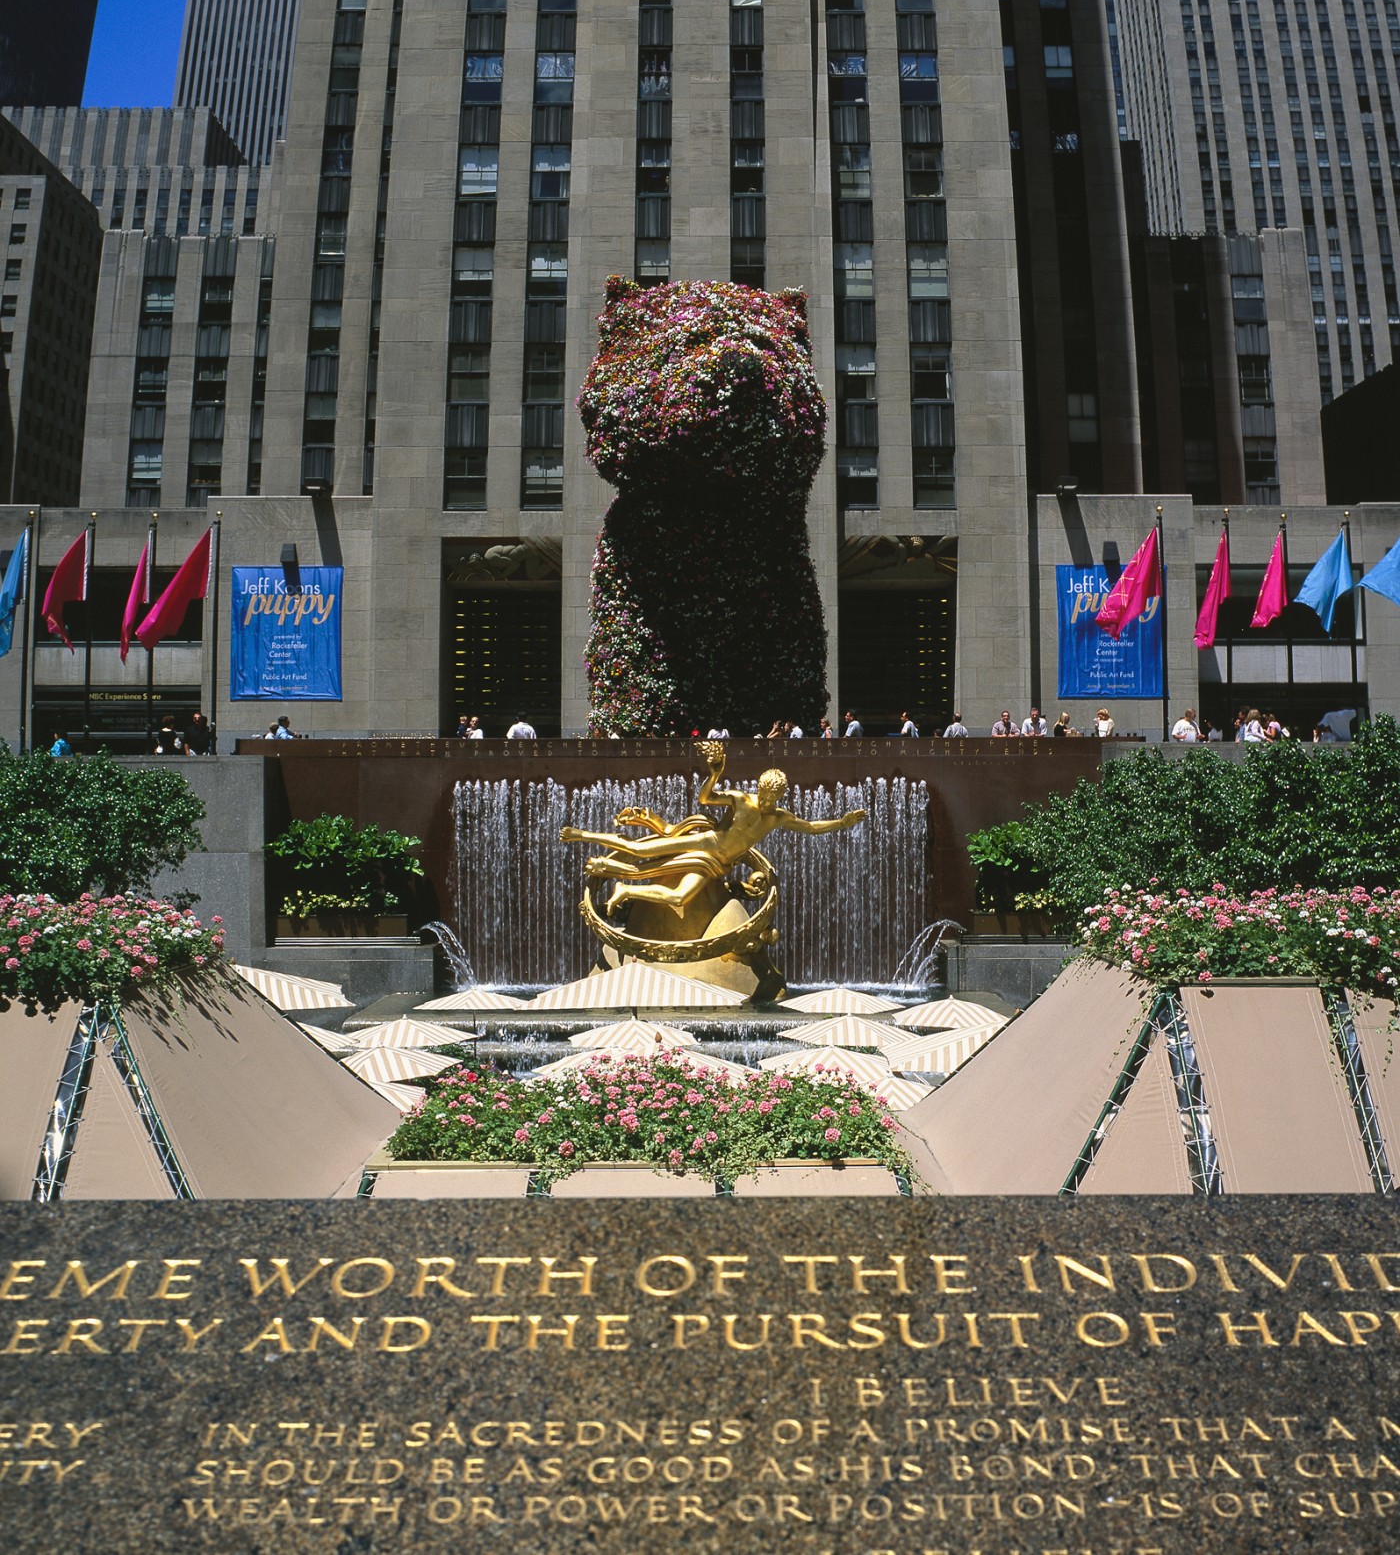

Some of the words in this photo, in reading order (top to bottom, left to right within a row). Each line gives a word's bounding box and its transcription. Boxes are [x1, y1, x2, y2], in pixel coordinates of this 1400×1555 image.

[241, 577, 269, 595] Jeff
[274, 579, 321, 595] Koons
[1066, 575, 1094, 593] Jeff
[244, 593, 335, 626] puppy
[1071, 592, 1160, 624] puy
[292, 672, 307, 680] Fund
[1119, 670, 1135, 678] Fund
[620, 749, 702, 757] MORTAL
[0, 1259, 201, 1301] EME
[238, 1256, 598, 1299] WORTH
[637, 1254, 749, 1297] OF
[783, 1254, 975, 1295] THE
[0, 1317, 224, 1355] ERTY
[240, 1316, 433, 1354] AND
[470, 1314, 631, 1351] THE
[670, 1312, 1041, 1349] PURSUIT
[1074, 1310, 1178, 1347] OF
[810, 1377, 827, 1408] I
[854, 1376, 1128, 1408] BELIEVE
[202, 1422, 260, 1449] IN
[277, 1421, 379, 1449] THE
[405, 1419, 745, 1448] SACREDNESS
[771, 1418, 831, 1445] OF
[850, 1418, 881, 1445] A
[904, 1416, 1151, 1445] PROMISE,
[1159, 1416, 1299, 1442] THAT
[1323, 1416, 1357, 1441] A
[189, 1457, 405, 1486] SHOULD
[428, 1456, 487, 1485] BE
[499, 1456, 564, 1485] AS
[586, 1455, 734, 1484] GOOD
[756, 1455, 816, 1484] AS
[838, 1454, 924, 1483] HIS
[1129, 1453, 1272, 1480] THAT
[1295, 1452, 1400, 1479] CHA
[181, 1497, 405, 1525] WEALTH
[427, 1495, 507, 1525] OR
[523, 1494, 716, 1524] POWER
[734, 1494, 814, 1523] OR
[1211, 1491, 1271, 1519] OF
[1299, 1491, 1397, 1520] SUP
